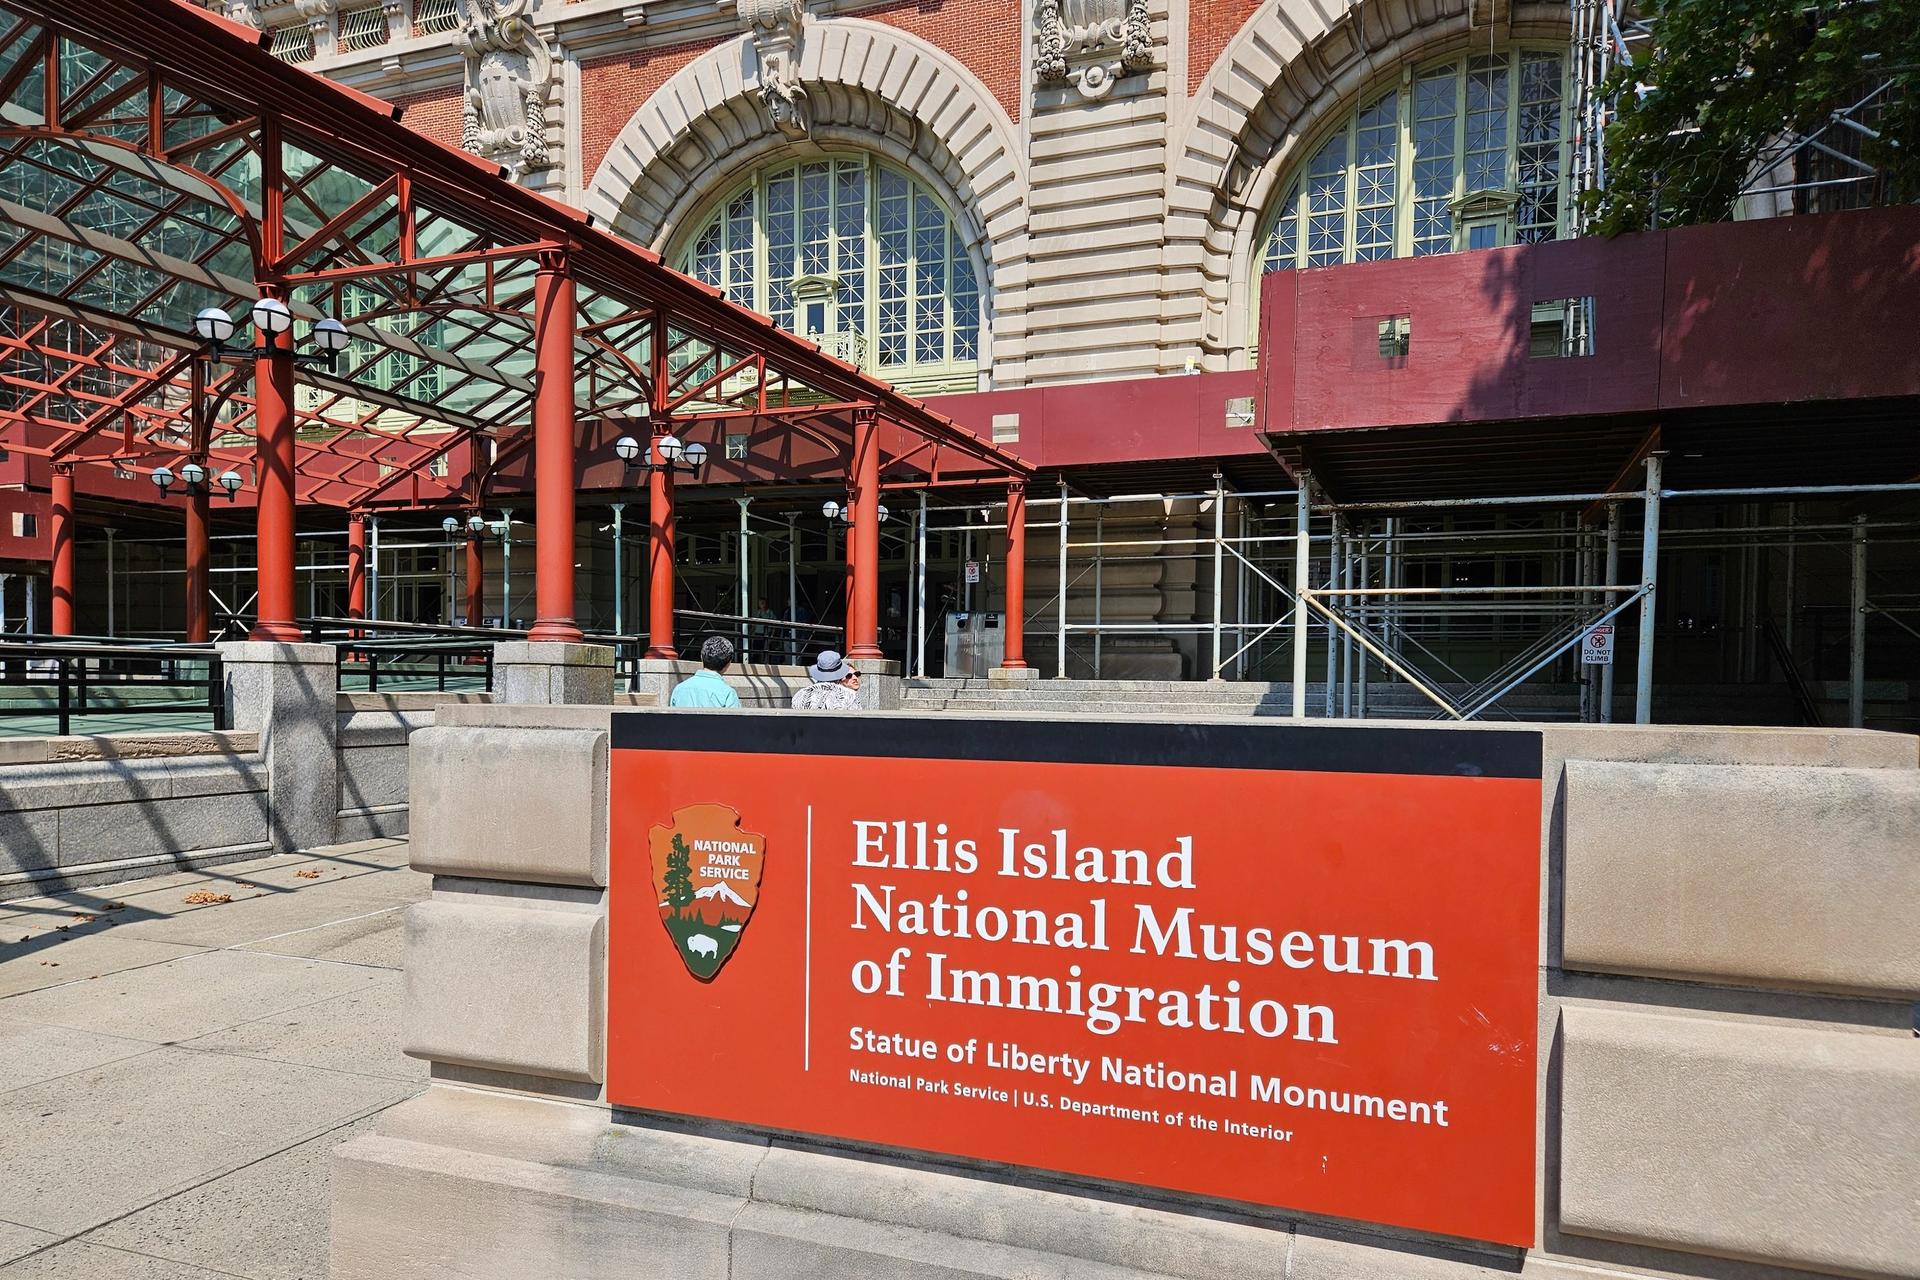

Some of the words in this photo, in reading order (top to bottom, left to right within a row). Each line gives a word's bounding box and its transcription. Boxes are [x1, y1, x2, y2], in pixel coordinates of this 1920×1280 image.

[694, 839, 756, 854] NATIONAL
[699, 866, 750, 880] SERVICE
[708, 853, 741, 866] PARK
[851, 819, 979, 874] Ellis
[997, 827, 1197, 889] Island
[850, 882, 1110, 952] National
[1129, 903, 1439, 982] Museum
[851, 946, 912, 997] of
[925, 952, 1340, 1046] Immigration
[849, 1026, 938, 1060] Statue
[946, 1038, 978, 1065] of
[987, 1042, 1091, 1085] Liberty
[1101, 1056, 1237, 1098] National
[1250, 1074, 1450, 1127] Monument
[849, 1068, 912, 1090] National
[916, 1077, 949, 1095] Park
[953, 1082, 1009, 1102] Service
[1023, 1091, 1055, 1109] U.S.
[1060, 1096, 1160, 1124] Department
[1164, 1111, 1184, 1127] of
[1188, 1114, 1218, 1131] the
[1223, 1119, 1294, 1142] Interior
